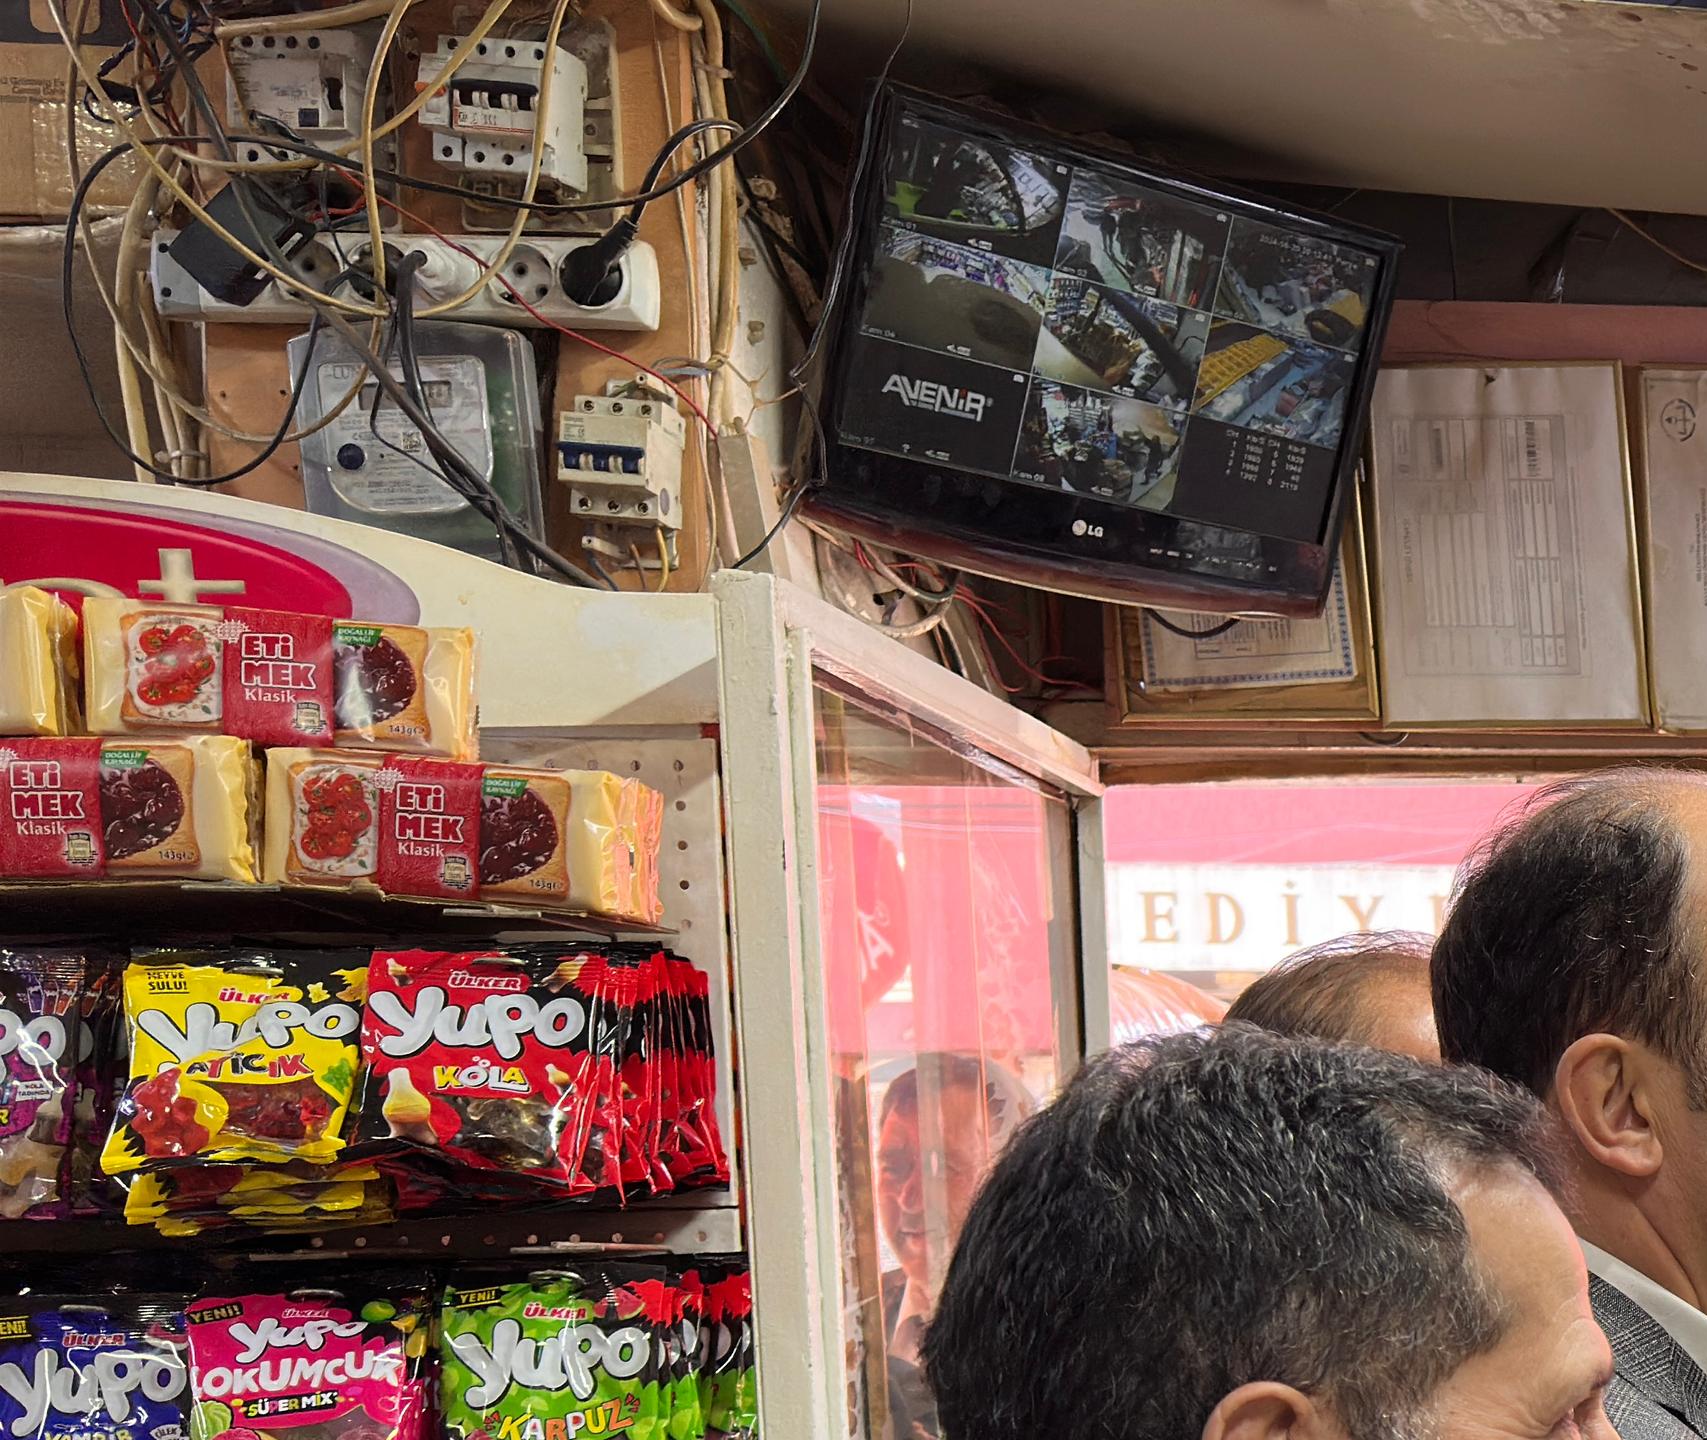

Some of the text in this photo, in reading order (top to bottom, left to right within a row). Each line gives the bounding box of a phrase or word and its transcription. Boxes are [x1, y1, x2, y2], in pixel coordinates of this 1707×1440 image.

[1088, 525, 1104, 538] LG
[241, 661, 317, 690] MEK
[244, 688, 297, 704] Klasik
[10, 791, 86, 820] MEK
[16, 820, 68, 838] Klasik
[395, 813, 465, 844] MEK
[398, 842, 445, 857] Klasik
[147, 979, 189, 993] SULU!
[448, 969, 523, 993] ÜLKER
[455, 1289, 497, 1306] YENİ!
[189, 1302, 242, 1326] YENİ!
[523, 1299, 589, 1320] ÜLKER
[62, 1330, 127, 1349] ÜLKER
[248, 1395, 300, 1418] SÜPER
